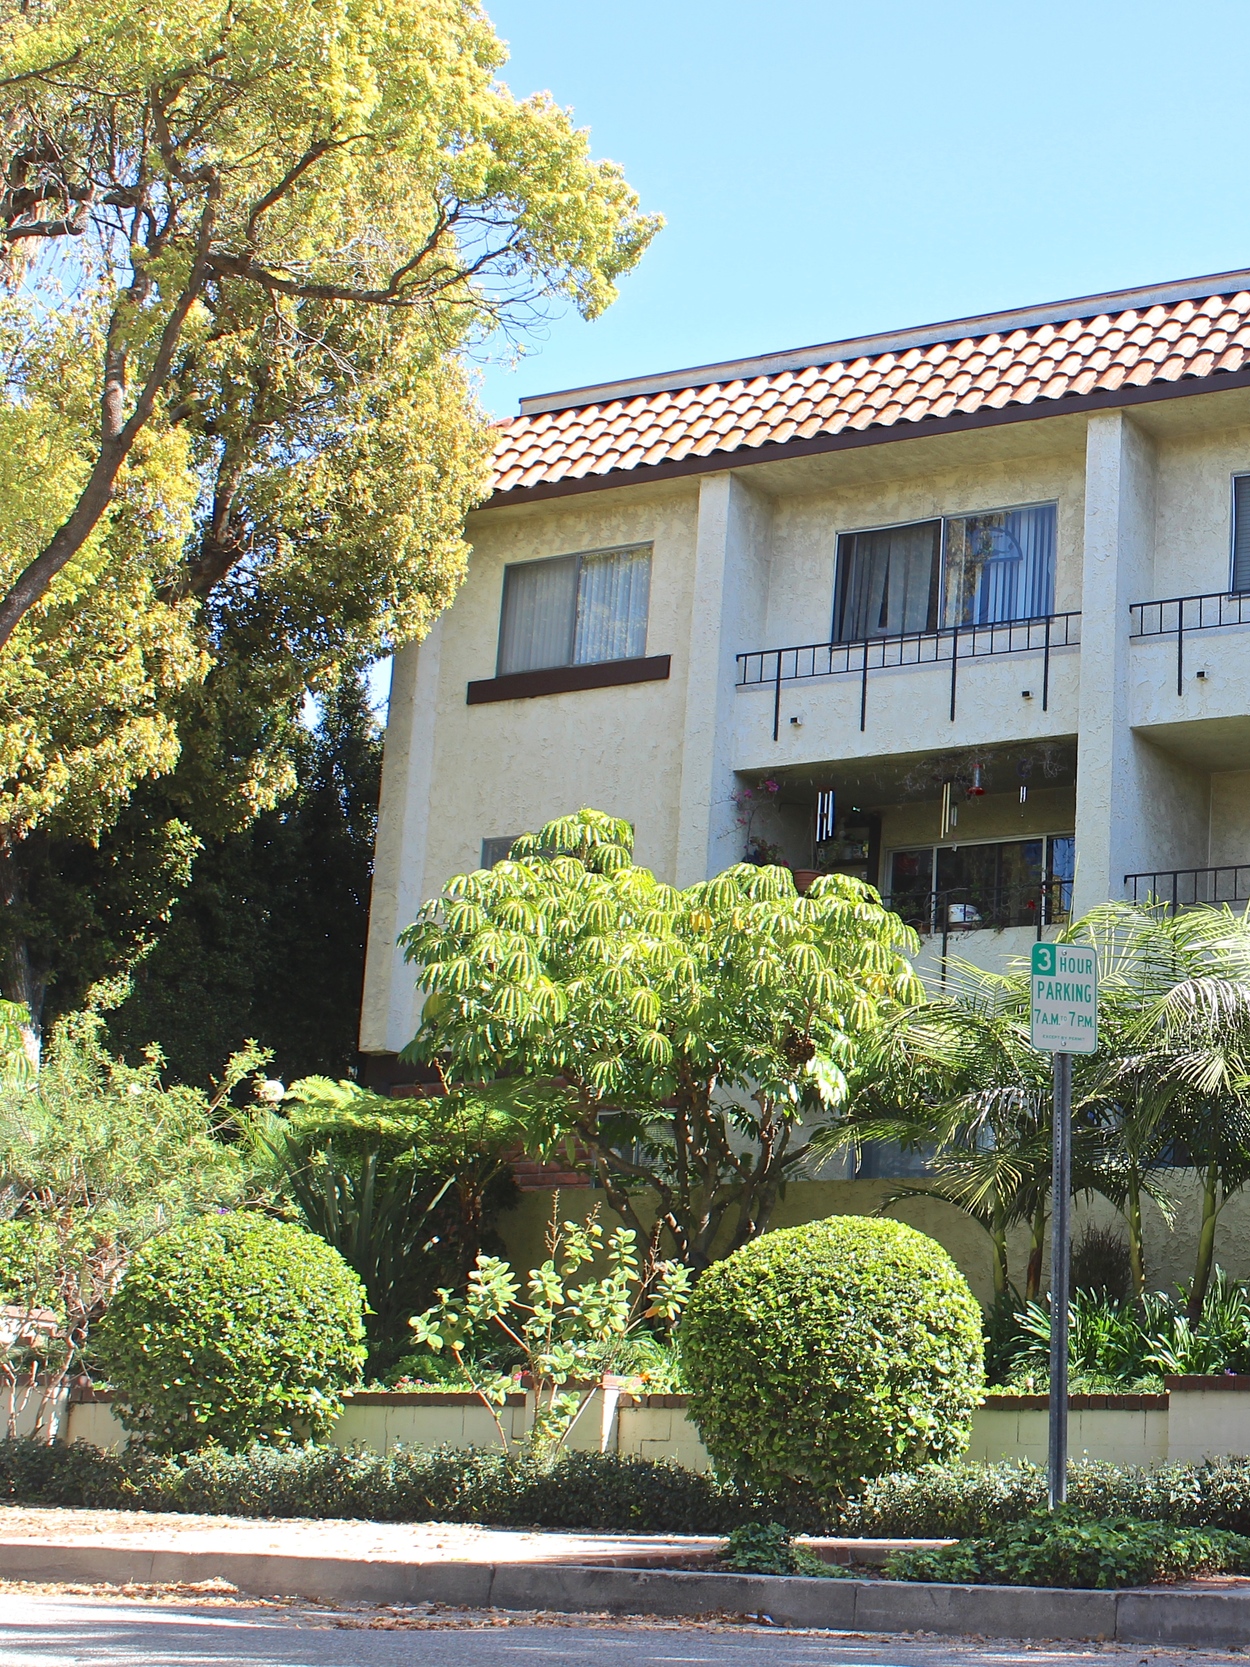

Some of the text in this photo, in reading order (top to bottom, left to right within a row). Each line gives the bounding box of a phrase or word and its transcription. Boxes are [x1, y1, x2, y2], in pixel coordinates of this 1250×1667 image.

[1037, 948, 1093, 974] 3 HOUR
[1037, 981, 1092, 1003] PARKING
[1034, 1009, 1041, 1024] 7
[1068, 1011, 1076, 1026] 7
